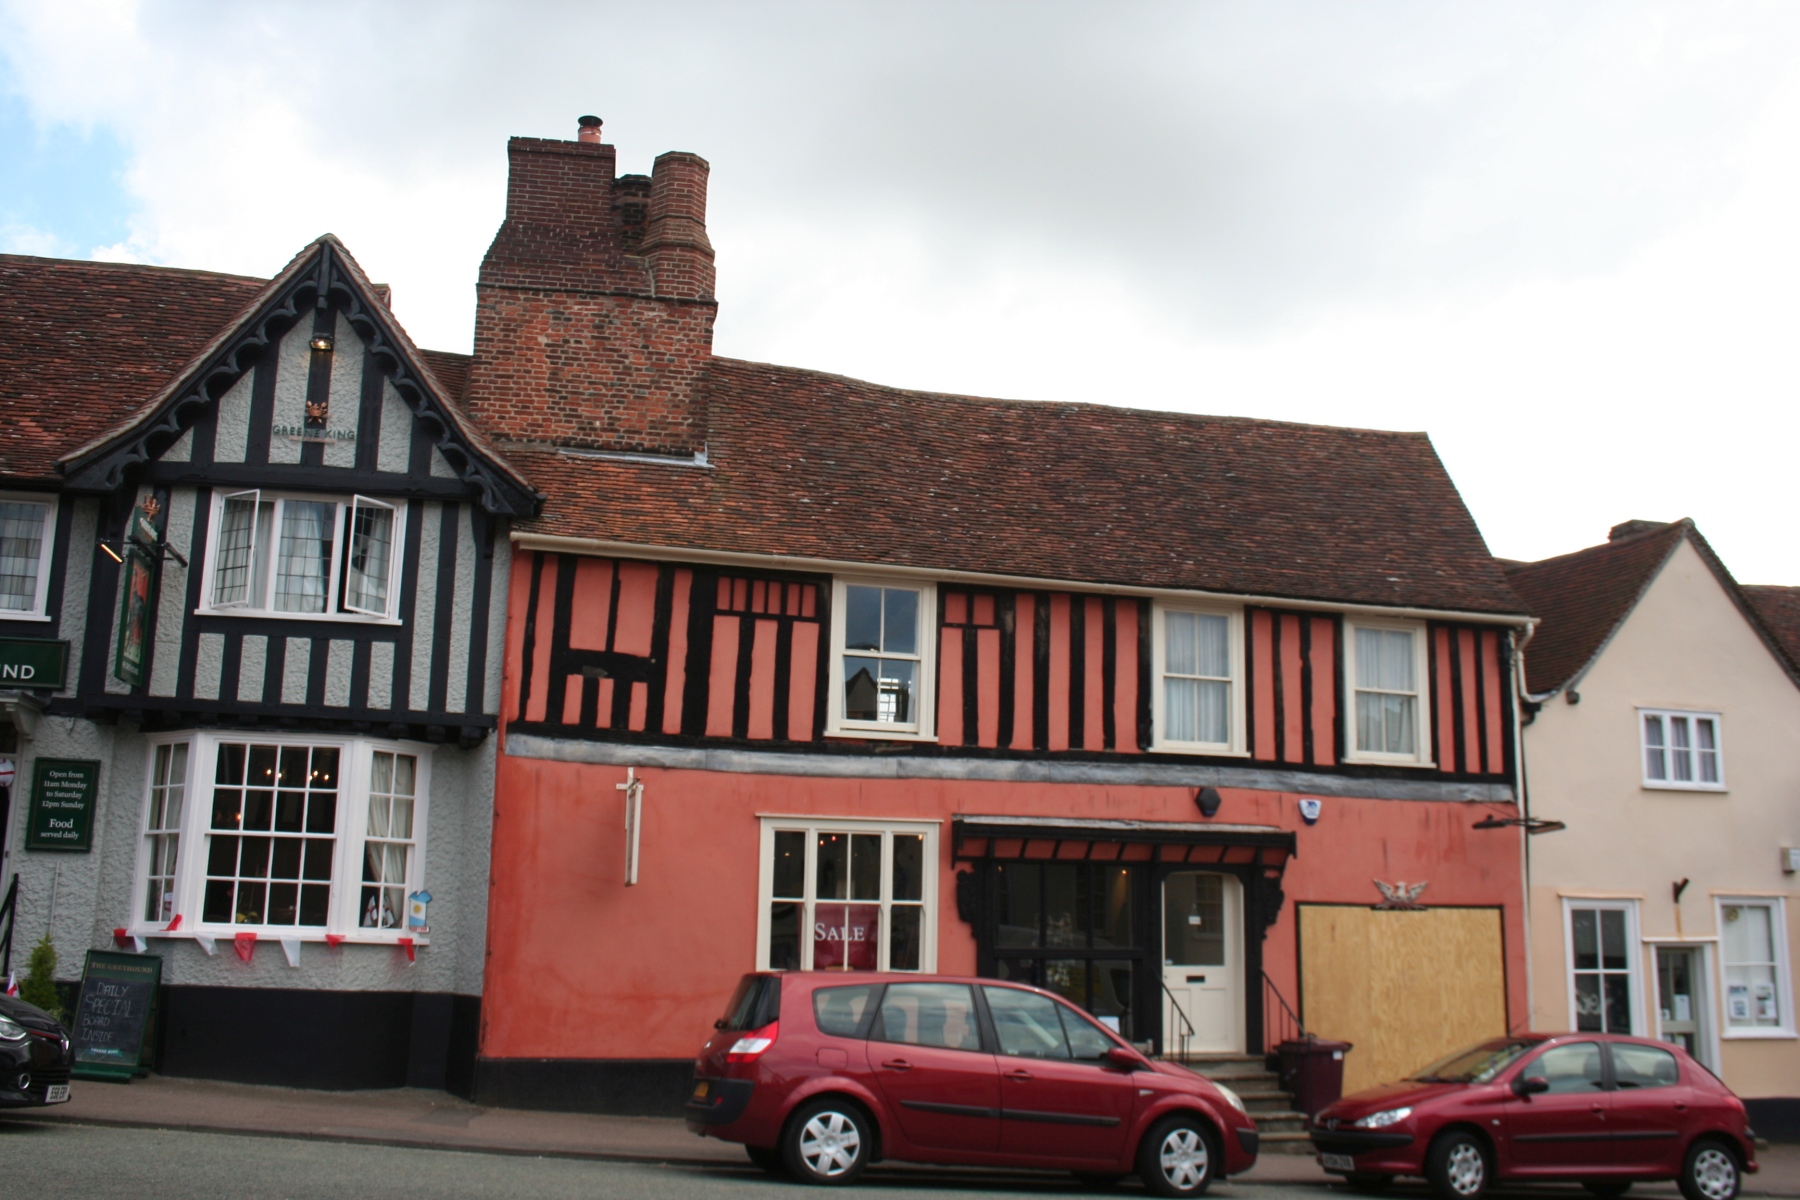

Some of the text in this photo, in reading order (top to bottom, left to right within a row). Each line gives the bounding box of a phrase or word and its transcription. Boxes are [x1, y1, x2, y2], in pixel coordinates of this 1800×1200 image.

[272, 425, 320, 438] GREENE
[324, 430, 355, 440] KING
[0, 664, 35, 679] ND
[49, 770, 84, 779] Open from
[61, 781, 88, 790] Monday
[54, 791, 83, 800] Saturday
[42, 800, 85, 810] 12pm Sunday
[49, 818, 74, 829] Food
[63, 831, 79, 840] daily
[815, 922, 865, 941] SALE
[107, 963, 153, 974] GREYHOUND
[96, 981, 129, 997] DAILY
[85, 994, 134, 1018] SPECIAL
